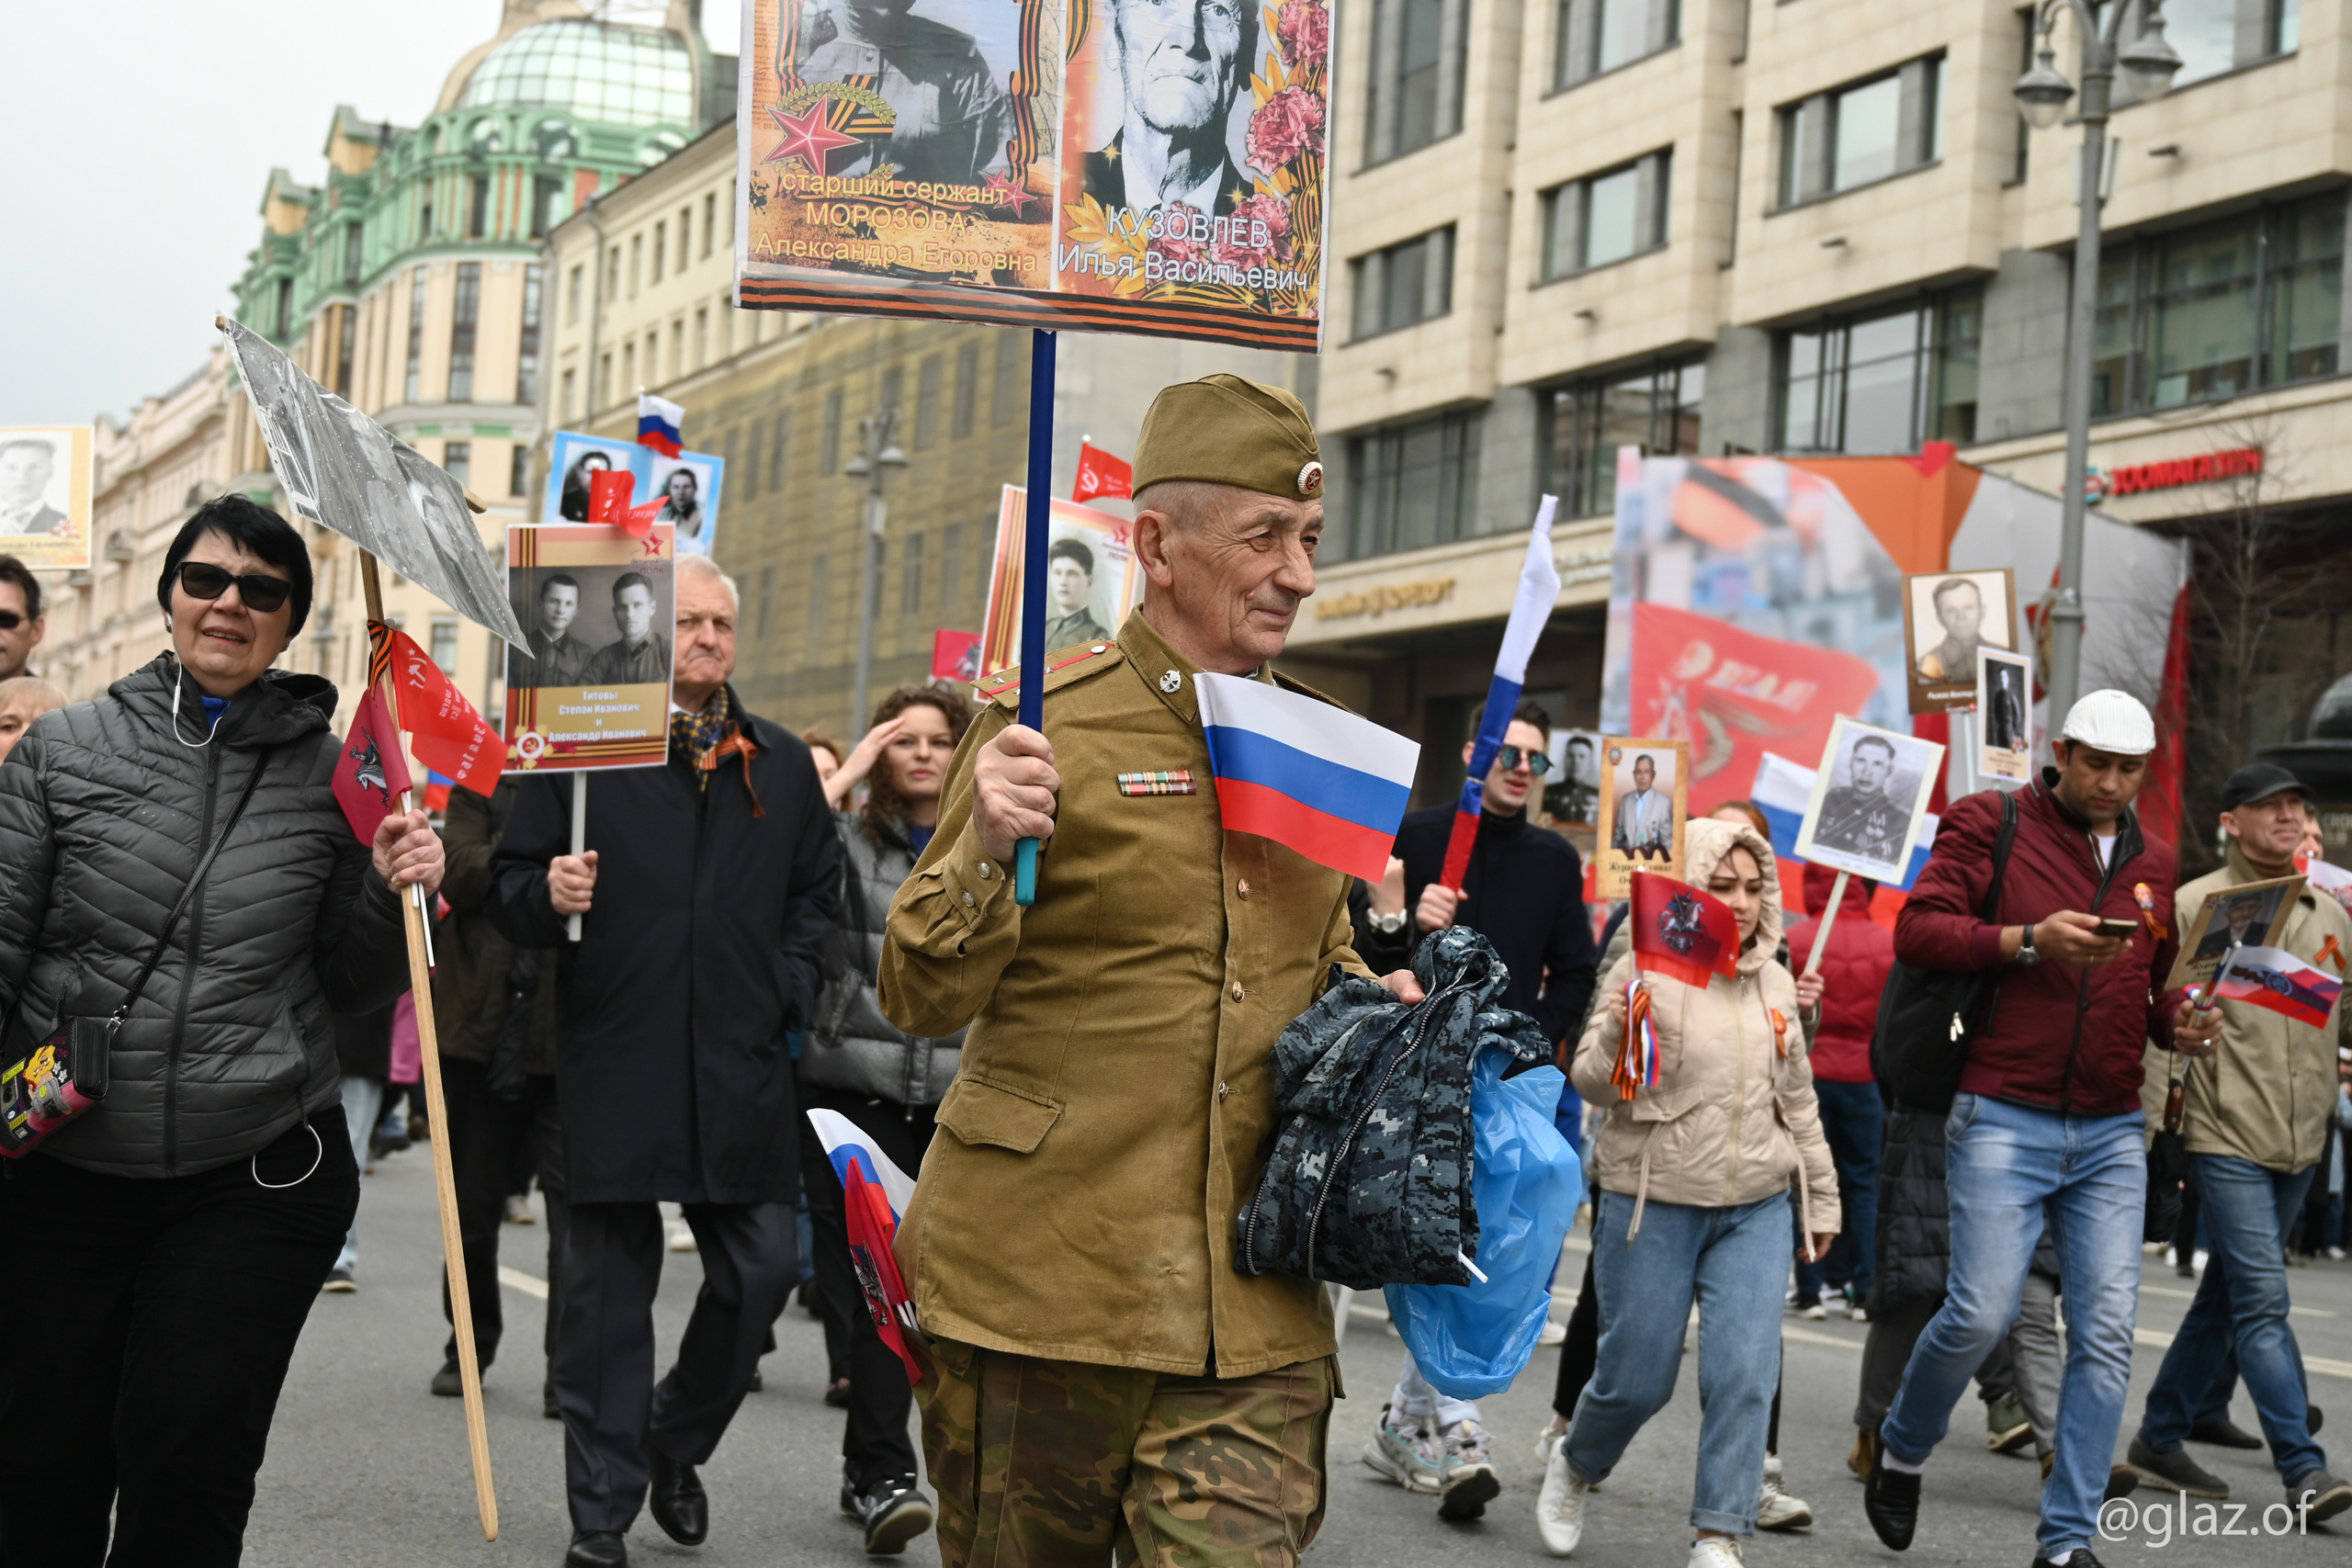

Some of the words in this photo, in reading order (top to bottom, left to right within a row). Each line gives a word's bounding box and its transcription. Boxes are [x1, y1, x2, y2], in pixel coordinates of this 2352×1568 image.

[782, 172, 895, 197] старший
[903, 182, 1008, 206] сержант
[807, 201, 967, 234] МОРОЗОВА
[1109, 205, 1269, 249] КУЗОВЛЕВ
[754, 231, 913, 266] Александра
[922, 243, 1037, 272] Егоровна
[1058, 243, 1135, 277] Илья
[1146, 250, 1308, 292] Васильевич
[2109, 446, 2264, 496] ЗООМАГАЗИН
[559, 705, 593, 716] Степан
[594, 703, 639, 715] Иванович
[582, 691, 618, 701] Титовы
[548, 731, 600, 742] Александр
[602, 728, 647, 739] Иванович
[595, 718, 603, 727] и
